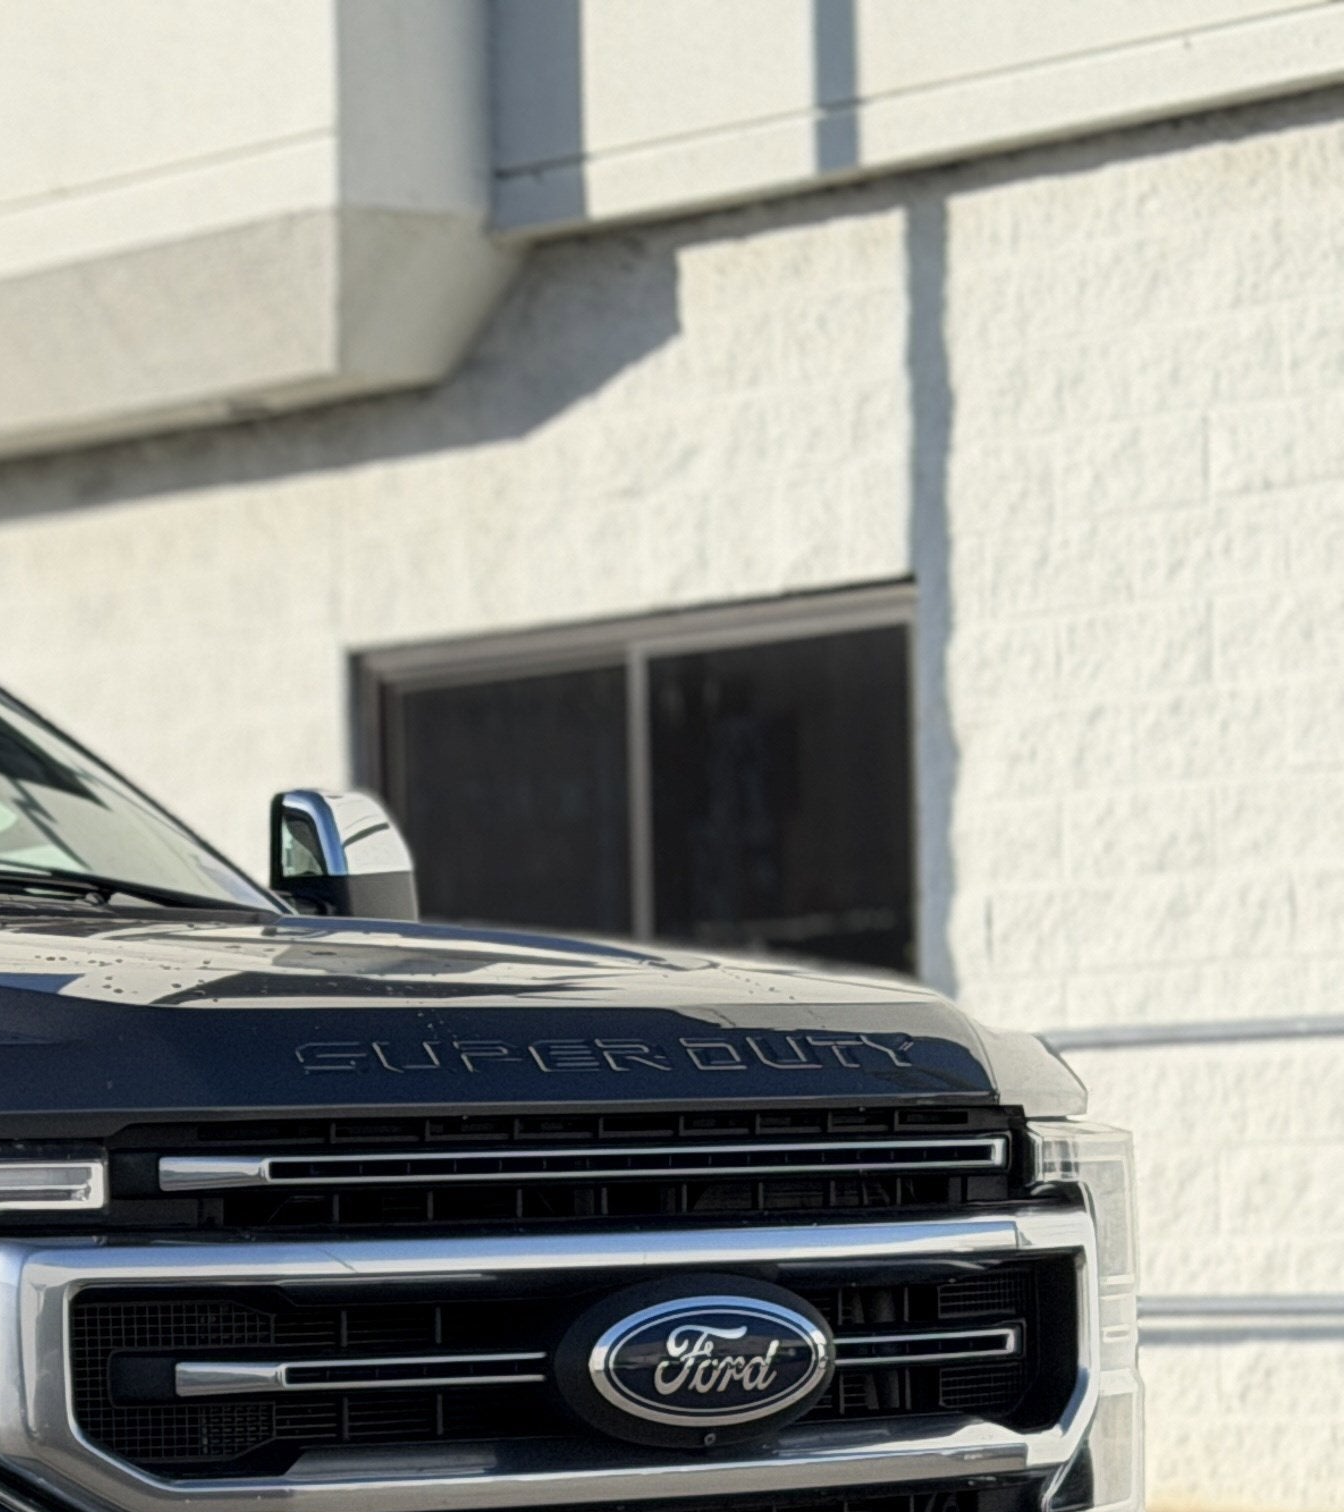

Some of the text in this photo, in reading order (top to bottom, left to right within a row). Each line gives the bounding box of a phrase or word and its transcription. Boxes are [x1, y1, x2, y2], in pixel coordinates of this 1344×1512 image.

[295, 1033, 914, 1074] SUPER DUTY
[653, 1324, 780, 1396] Ford
